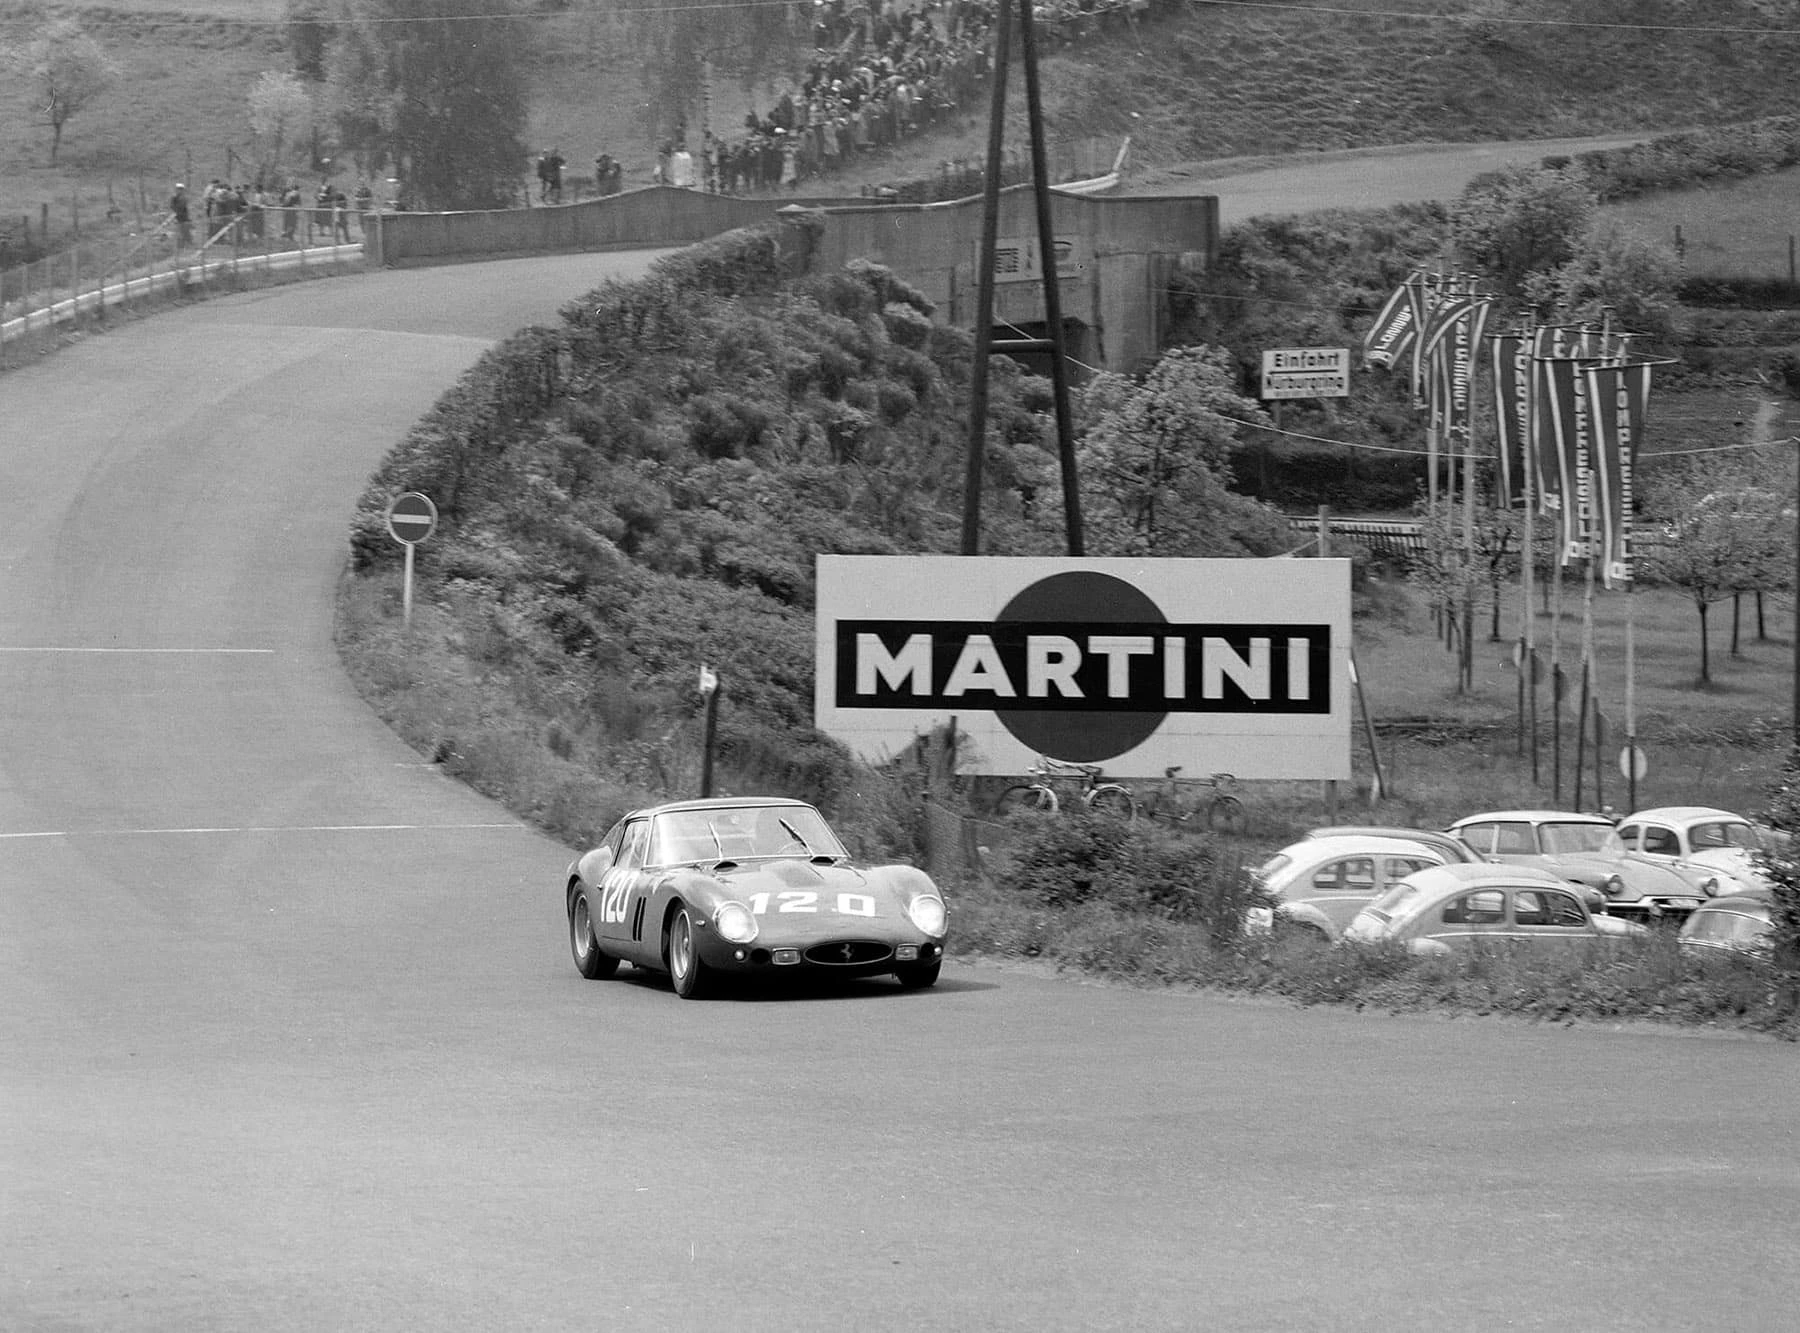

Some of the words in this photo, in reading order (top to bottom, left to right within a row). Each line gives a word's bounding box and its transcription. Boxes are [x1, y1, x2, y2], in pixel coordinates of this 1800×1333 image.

[1274, 351, 1339, 368] Einfahrt
[855, 633, 1311, 700] MARTINI
[600, 869, 640, 923] 120
